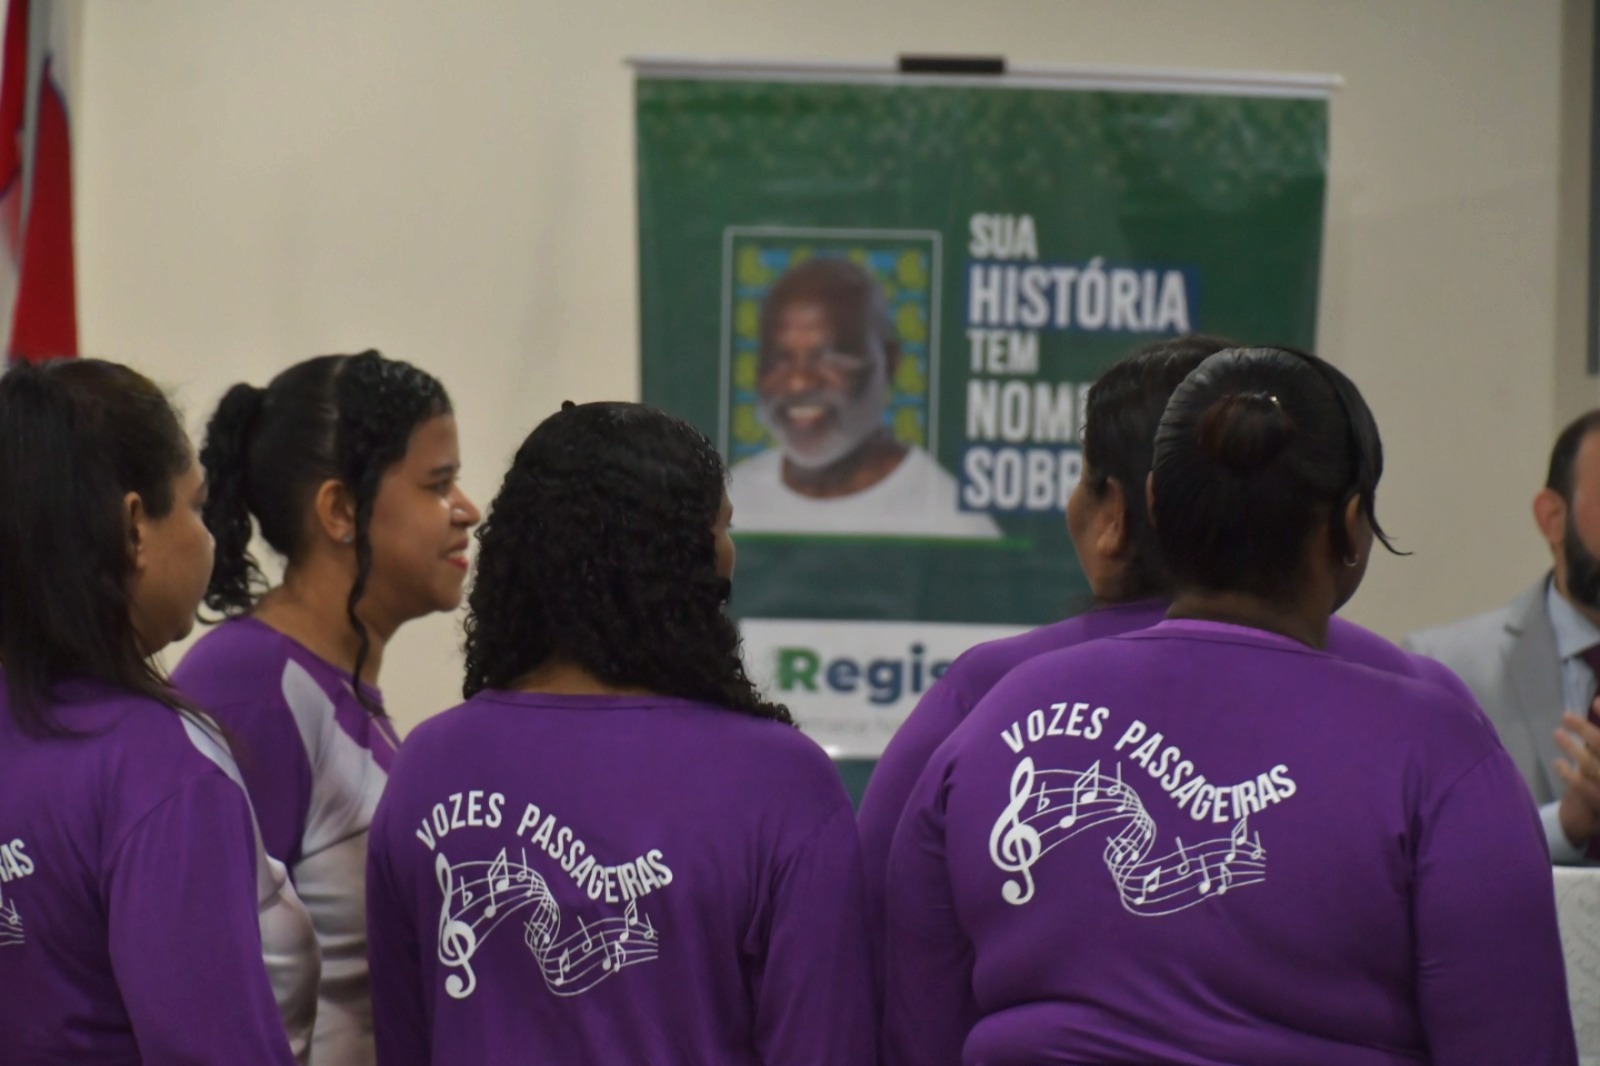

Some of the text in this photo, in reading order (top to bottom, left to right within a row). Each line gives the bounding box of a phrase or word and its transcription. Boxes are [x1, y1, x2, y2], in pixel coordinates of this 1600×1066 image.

[969, 213, 1037, 259] SUA
[969, 257, 1190, 332] HISTÓRIA
[968, 329, 1039, 373] TEM
[1000, 702, 1297, 823] VOZES PASSAGEIRAS
[416, 790, 673, 903] VOZES PASSAGEIRAS
